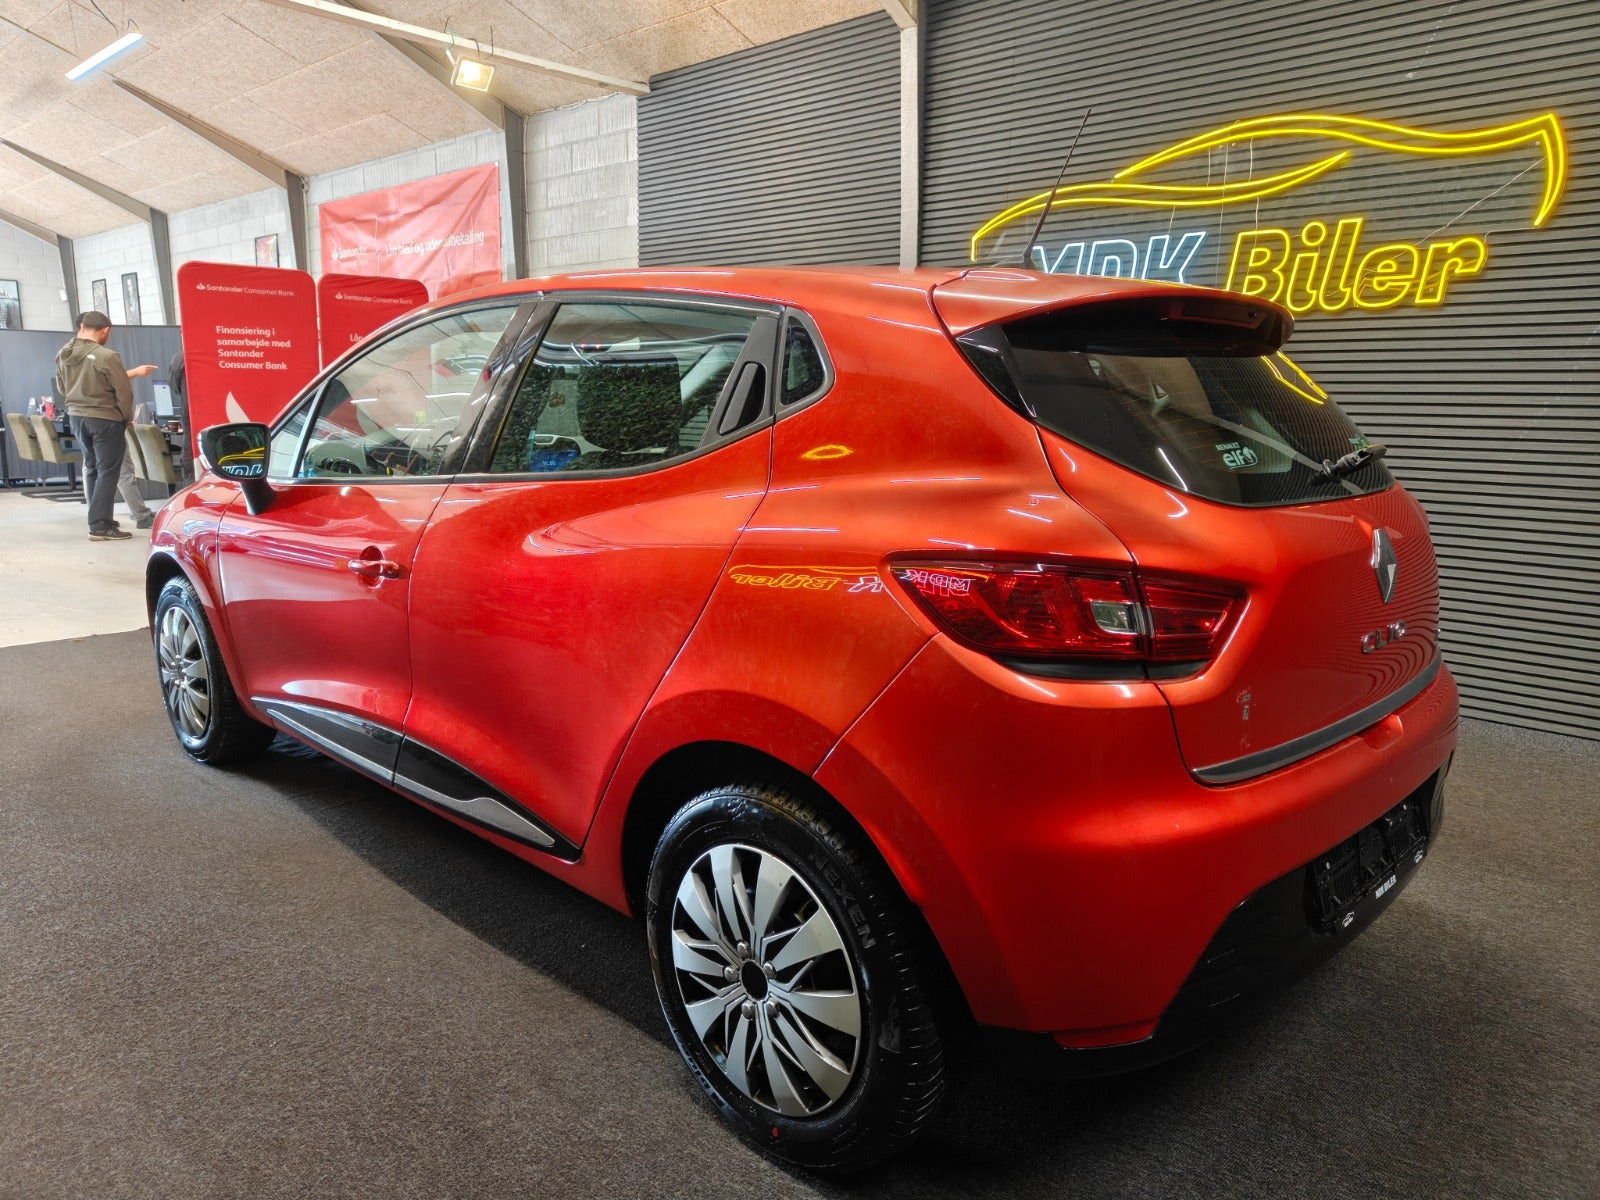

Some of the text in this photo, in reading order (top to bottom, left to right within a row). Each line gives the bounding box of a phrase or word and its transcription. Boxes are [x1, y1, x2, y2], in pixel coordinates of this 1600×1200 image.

[1225, 216, 1487, 312] Biler
[206, 284, 296, 297] Santander Consumer Bank
[343, 294, 372, 303] Santander
[215, 325, 271, 338] Finansiering
[216, 337, 292, 348] samarbejde med
[217, 348, 265, 358] Santander
[218, 360, 288, 370] Consumer Bank
[1222, 449, 1245, 467] elf
[1361, 619, 1407, 655] CLIO
[808, 852, 877, 949] NEXEN
